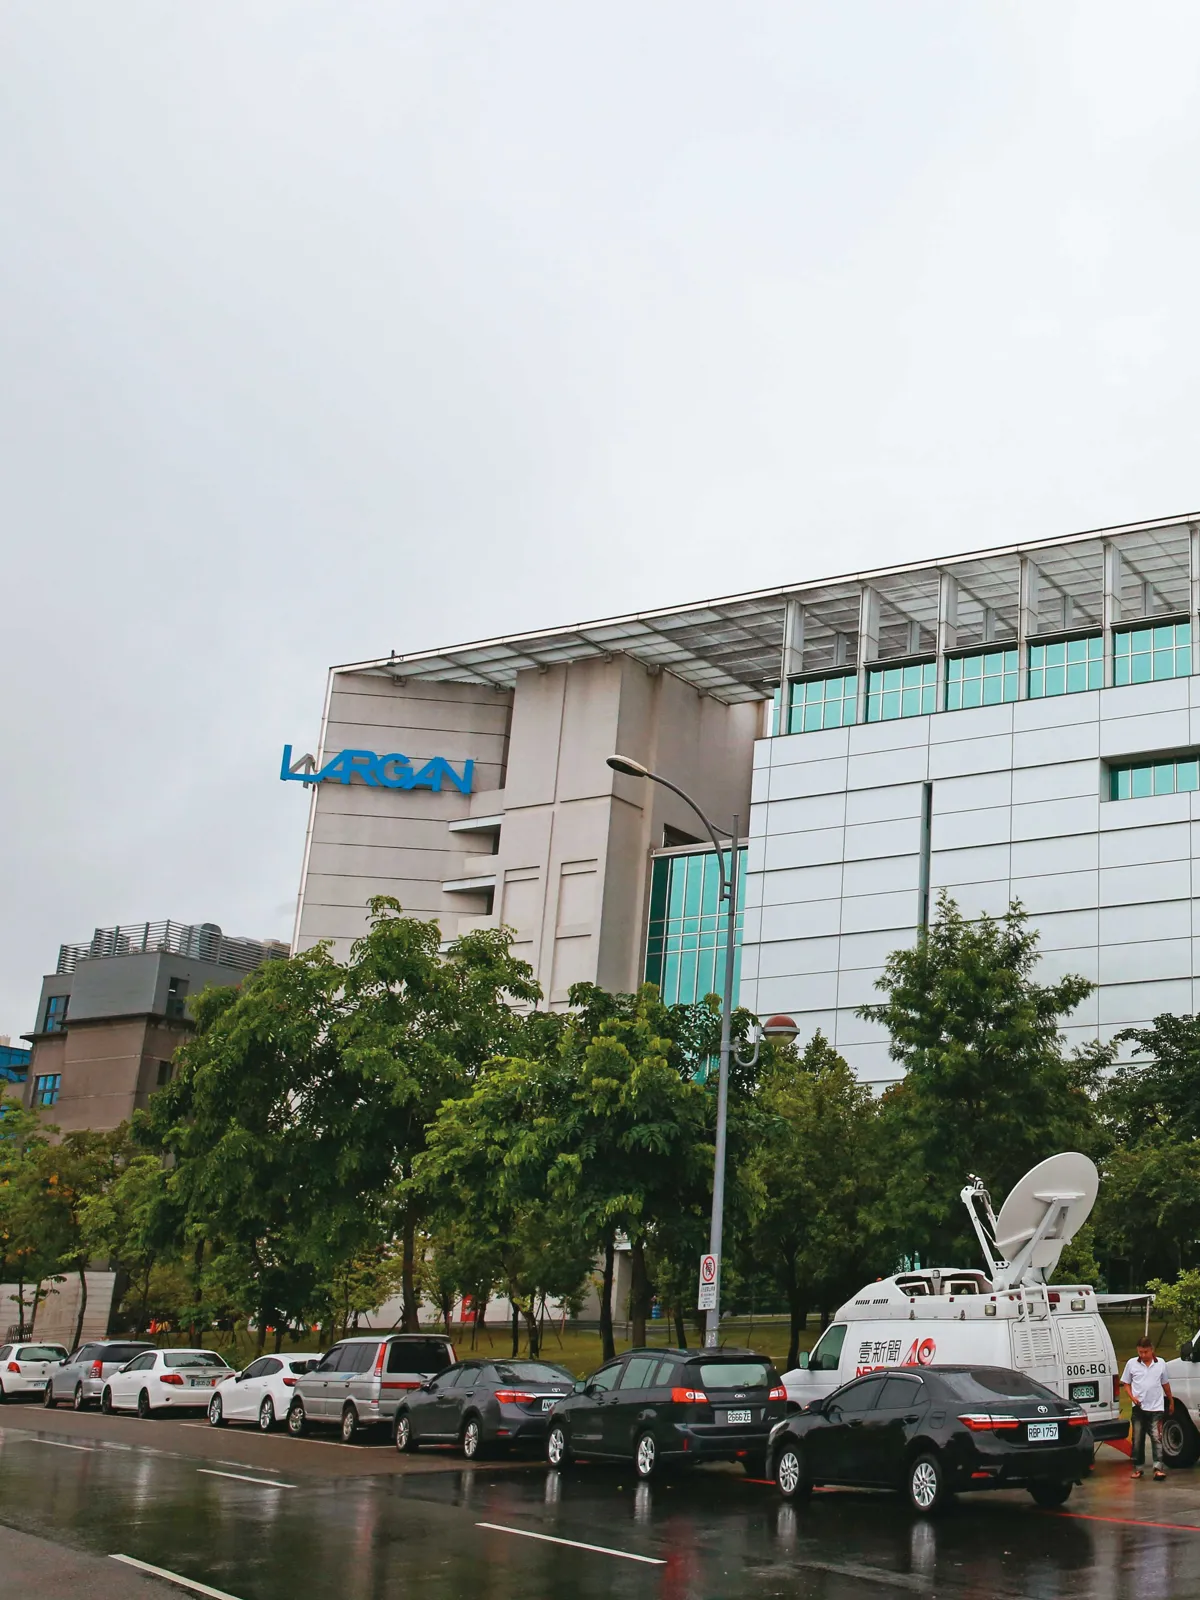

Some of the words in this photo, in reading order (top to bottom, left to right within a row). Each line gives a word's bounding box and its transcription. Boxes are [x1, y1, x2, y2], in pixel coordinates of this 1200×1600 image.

[280, 744, 474, 795] LARGAN
[858, 1340, 901, 1363] 壹新聞
[1067, 1363, 1106, 1376] 806-BQ
[1028, 1426, 1058, 1439] RBP-1757
